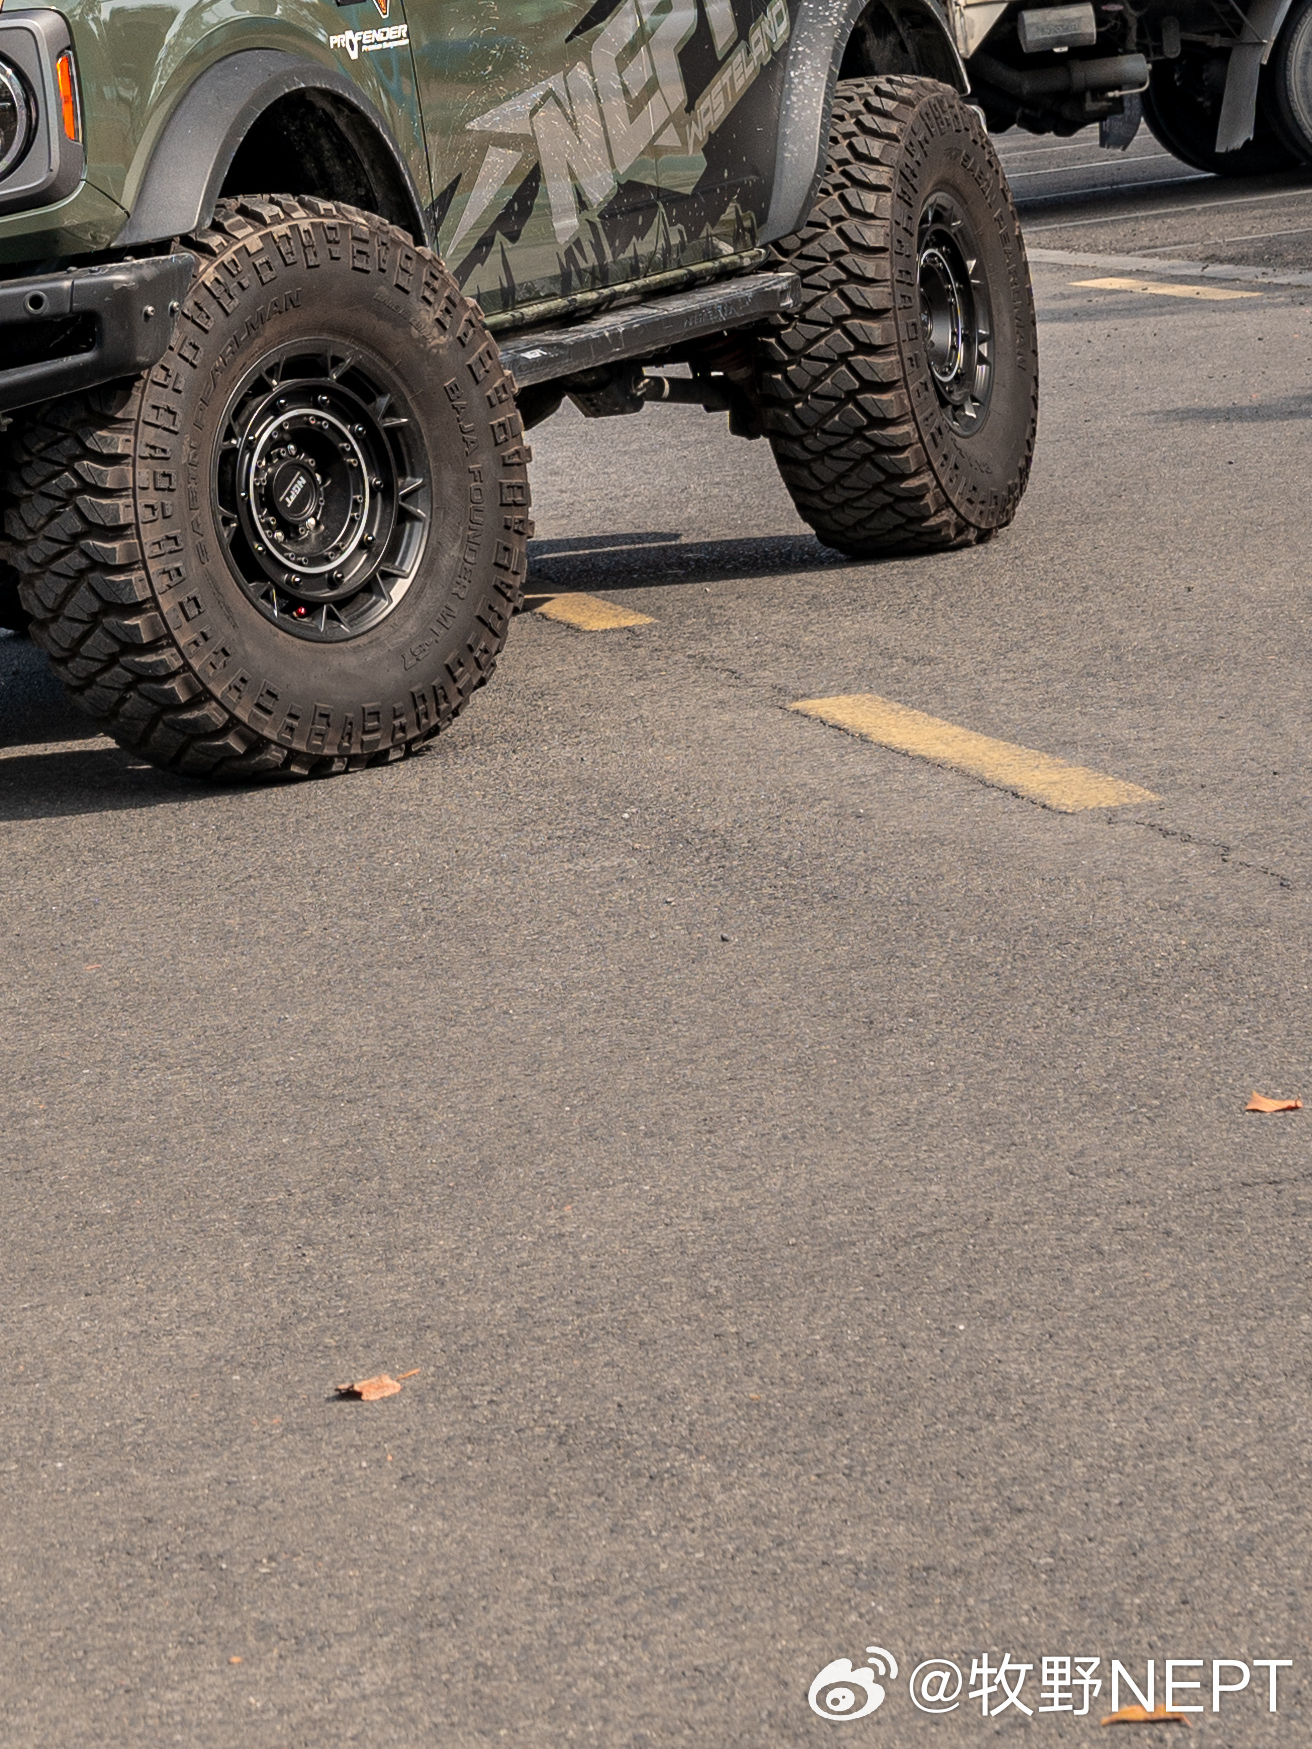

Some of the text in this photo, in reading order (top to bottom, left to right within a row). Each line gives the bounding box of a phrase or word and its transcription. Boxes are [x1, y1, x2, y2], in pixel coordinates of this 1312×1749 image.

[329, 23, 408, 61] PROFENDER
[443, 376, 480, 457] BAJA
[452, 464, 484, 600] FOUNDER
